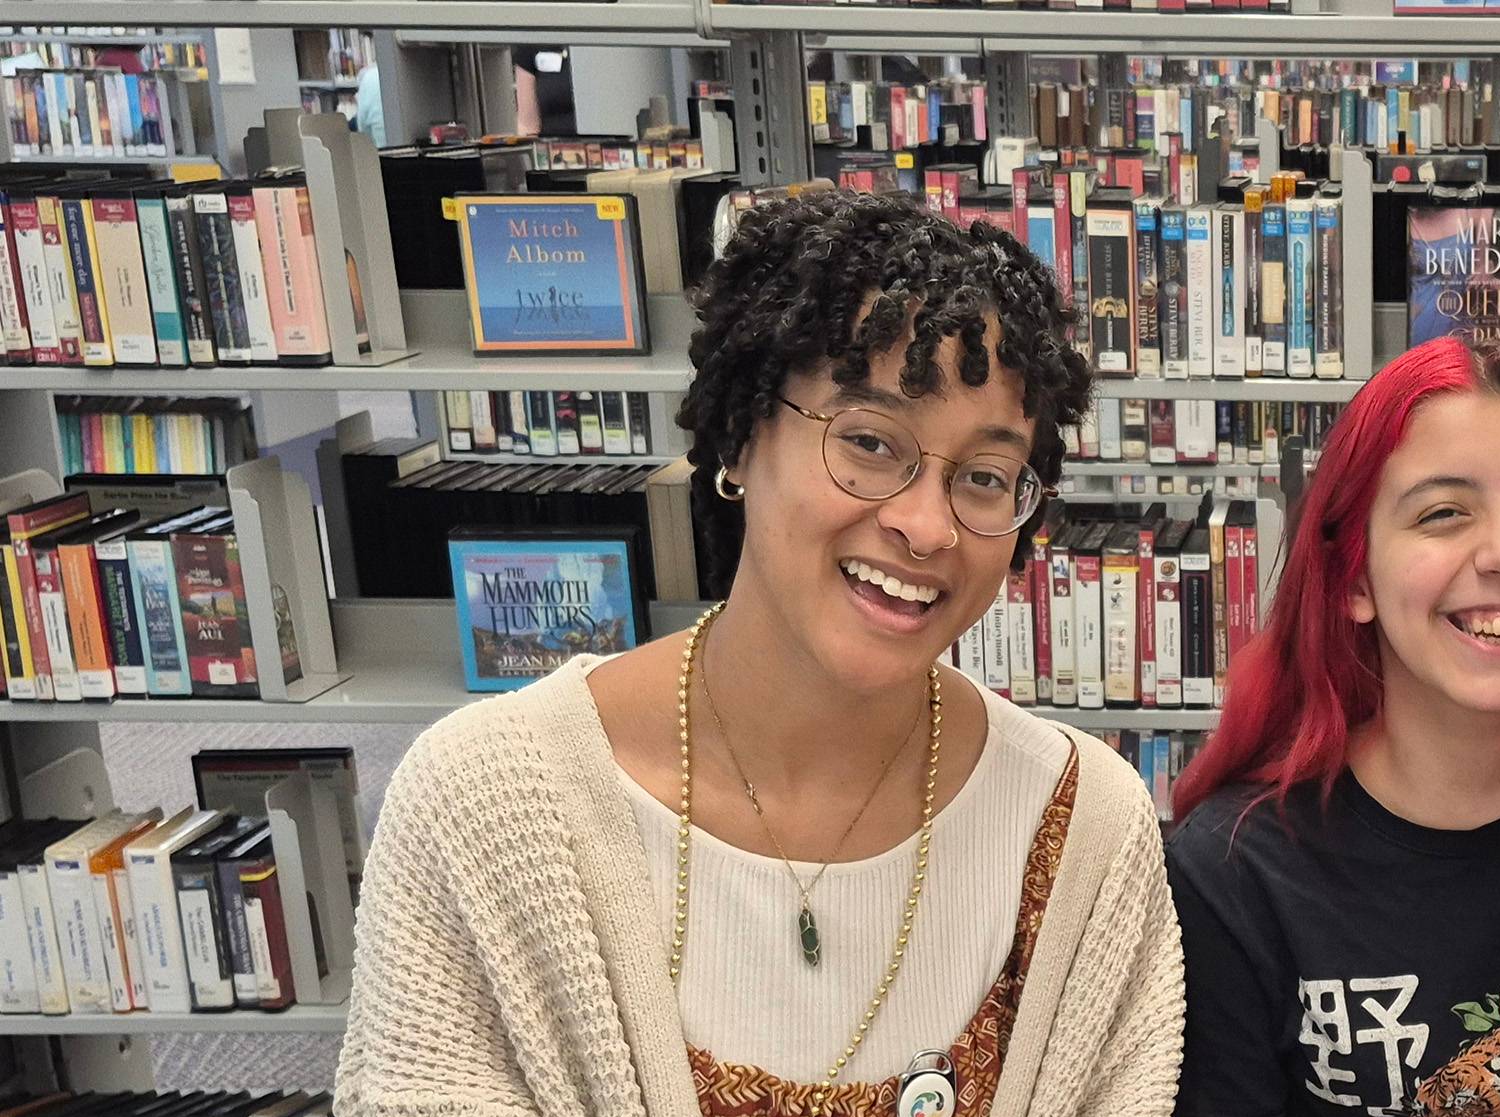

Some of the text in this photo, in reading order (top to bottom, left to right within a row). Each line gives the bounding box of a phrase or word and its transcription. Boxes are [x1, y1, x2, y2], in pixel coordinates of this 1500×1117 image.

[601, 204, 620, 214] NEW
[508, 218, 580, 238] Mitch
[68, 206, 88, 287] for one more day
[506, 244, 586, 264] Albom
[1138, 304, 1150, 342] BERRY
[1148, 299, 1158, 339] STEVE
[1168, 298, 1178, 360] STEVE BERRY
[480, 572, 590, 605] MAMMOTH
[504, 567, 526, 580] THE
[488, 606, 596, 638] HUNTERS
[994, 608, 1007, 667] Honeymoon
[498, 655, 544, 668] JEAN
[972, 626, 981, 669] Ways to Die
